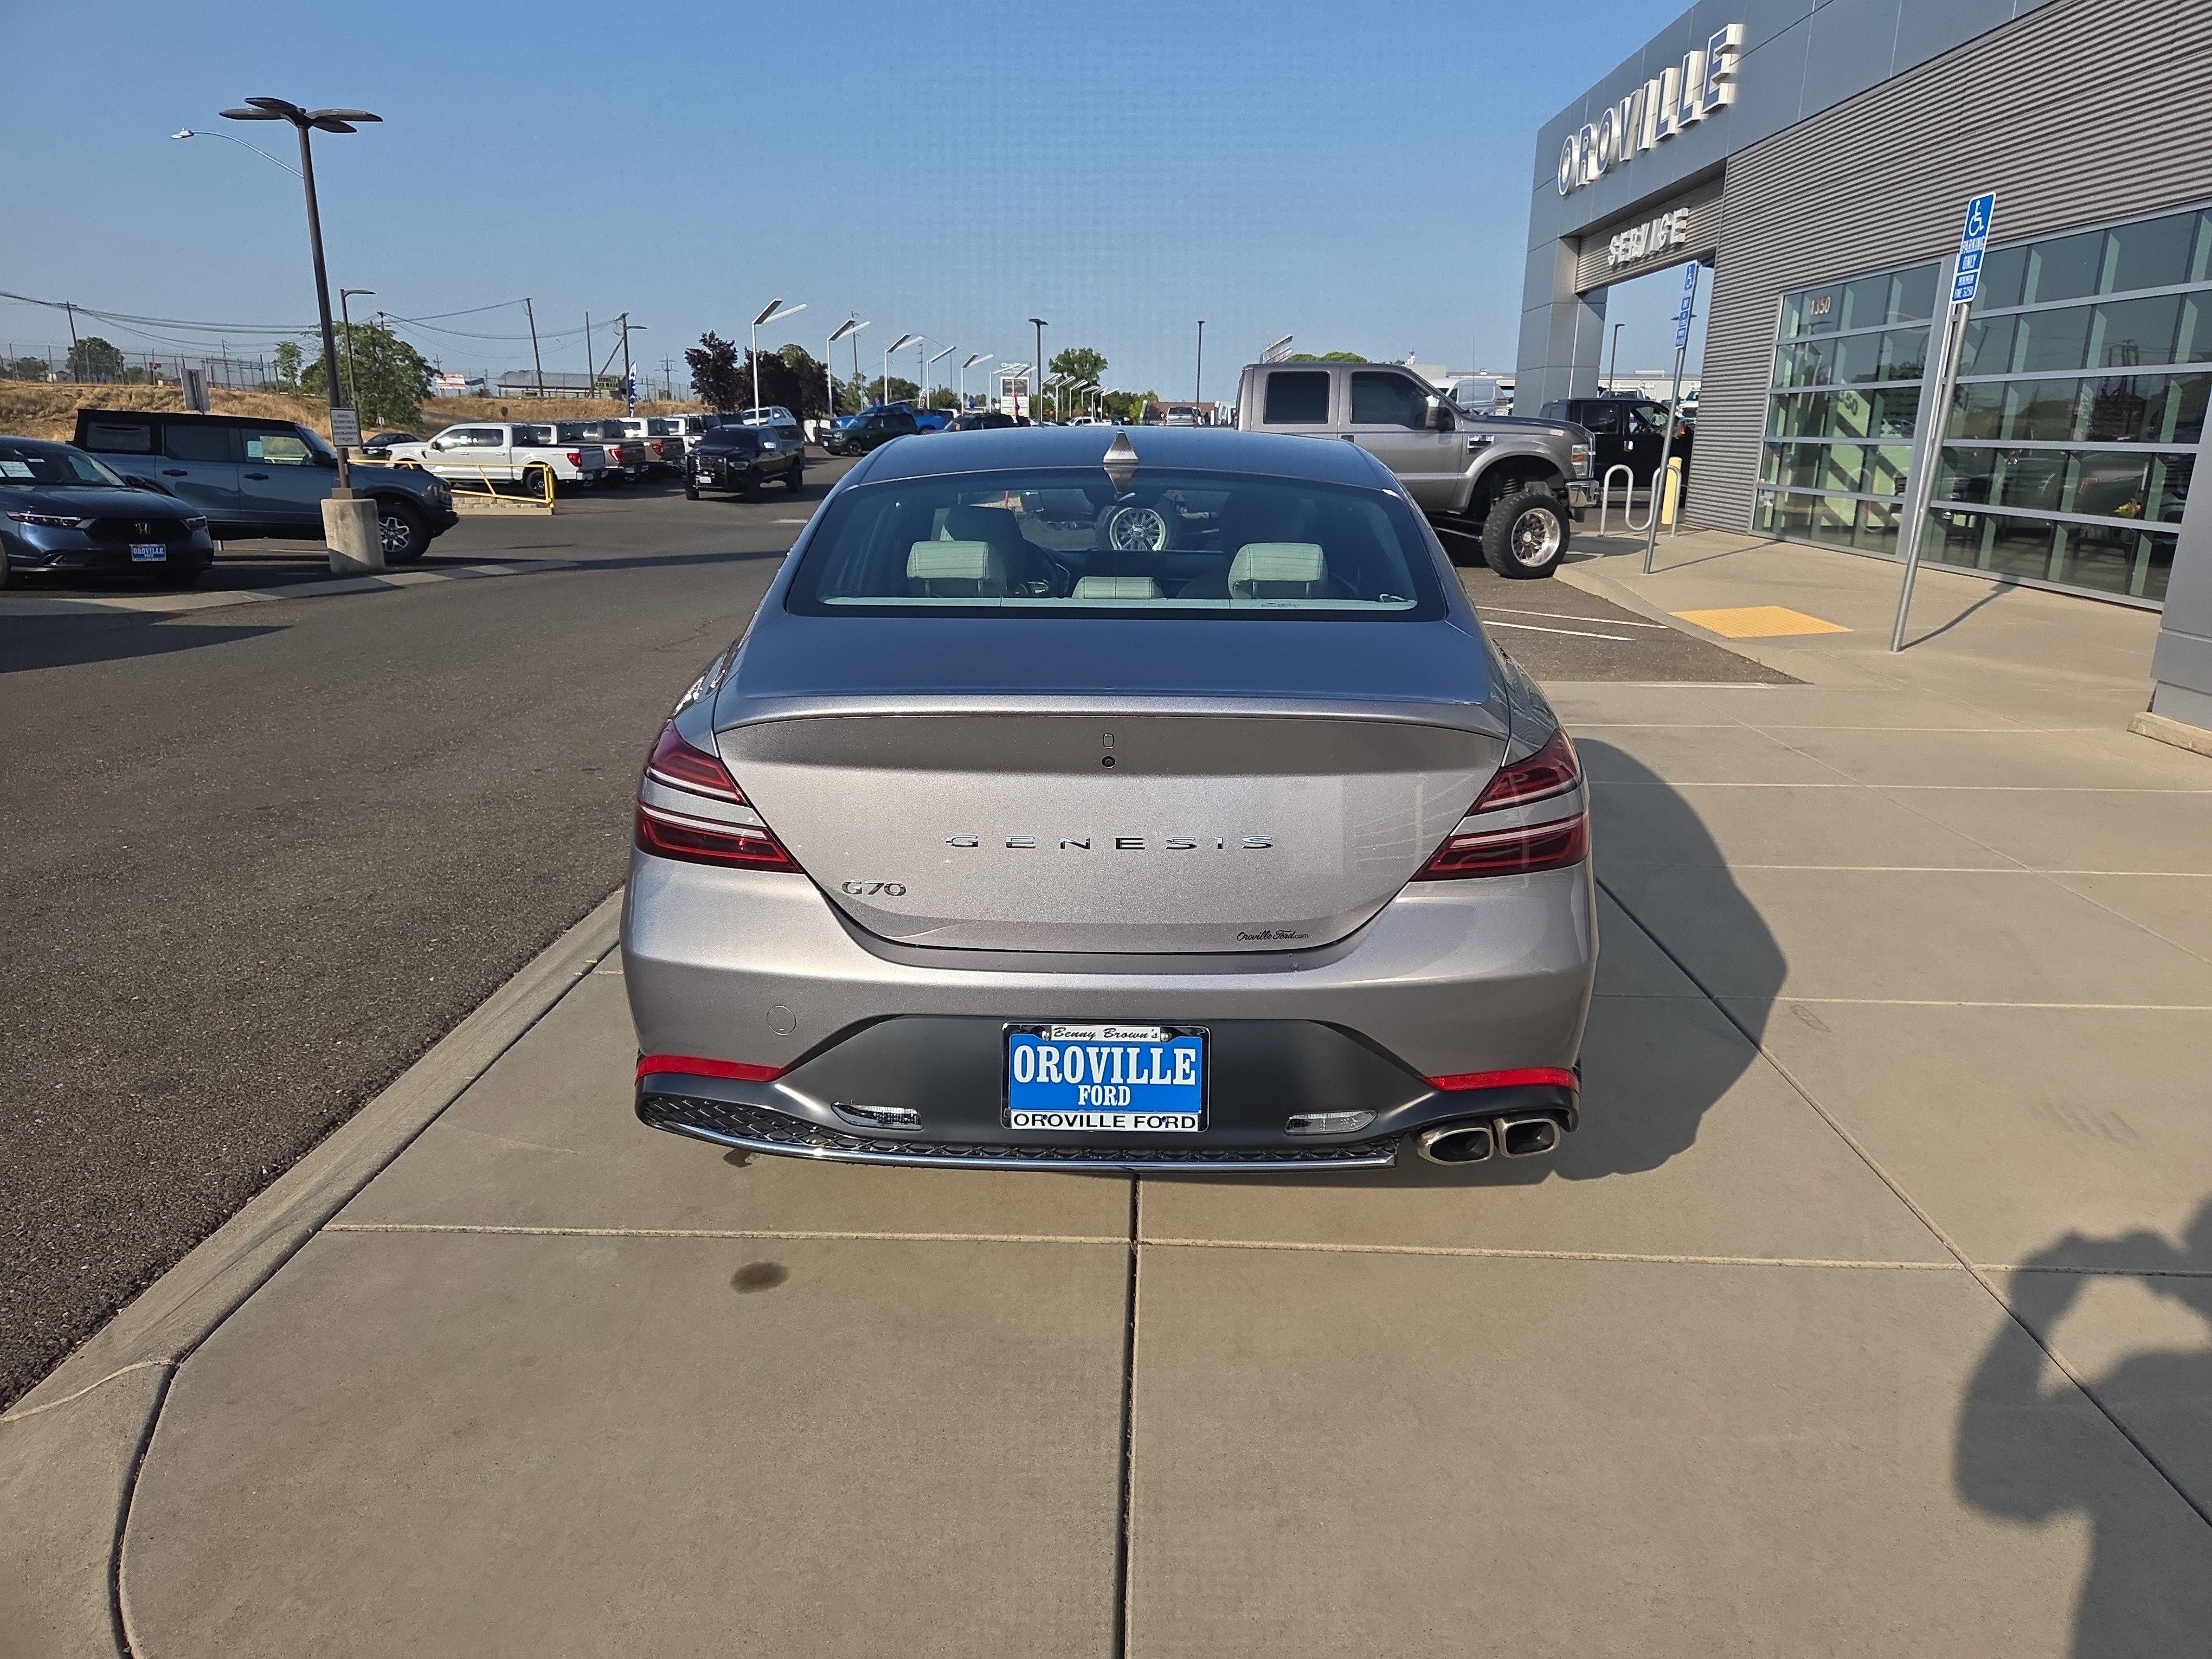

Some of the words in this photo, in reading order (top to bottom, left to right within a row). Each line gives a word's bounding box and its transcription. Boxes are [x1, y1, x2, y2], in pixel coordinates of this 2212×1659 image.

[1558, 23, 1743, 196] OROVILLE
[1607, 208, 1689, 266] SERVICE
[1960, 236, 1985, 254] PARKING
[1962, 253, 1978, 270] ONLY
[1811, 297, 1830, 316] 1350
[945, 834, 1274, 851] GENESIS
[841, 879, 906, 896] G70
[1053, 1027, 1096, 1041] Benny
[1103, 1028, 1159, 1039] Brown's
[1013, 1045, 1196, 1085] OROVILLE
[1078, 1085, 1131, 1107] FORD
[1013, 1113, 1126, 1128] OROVILLE
[1133, 1115, 1196, 1129] FORD
